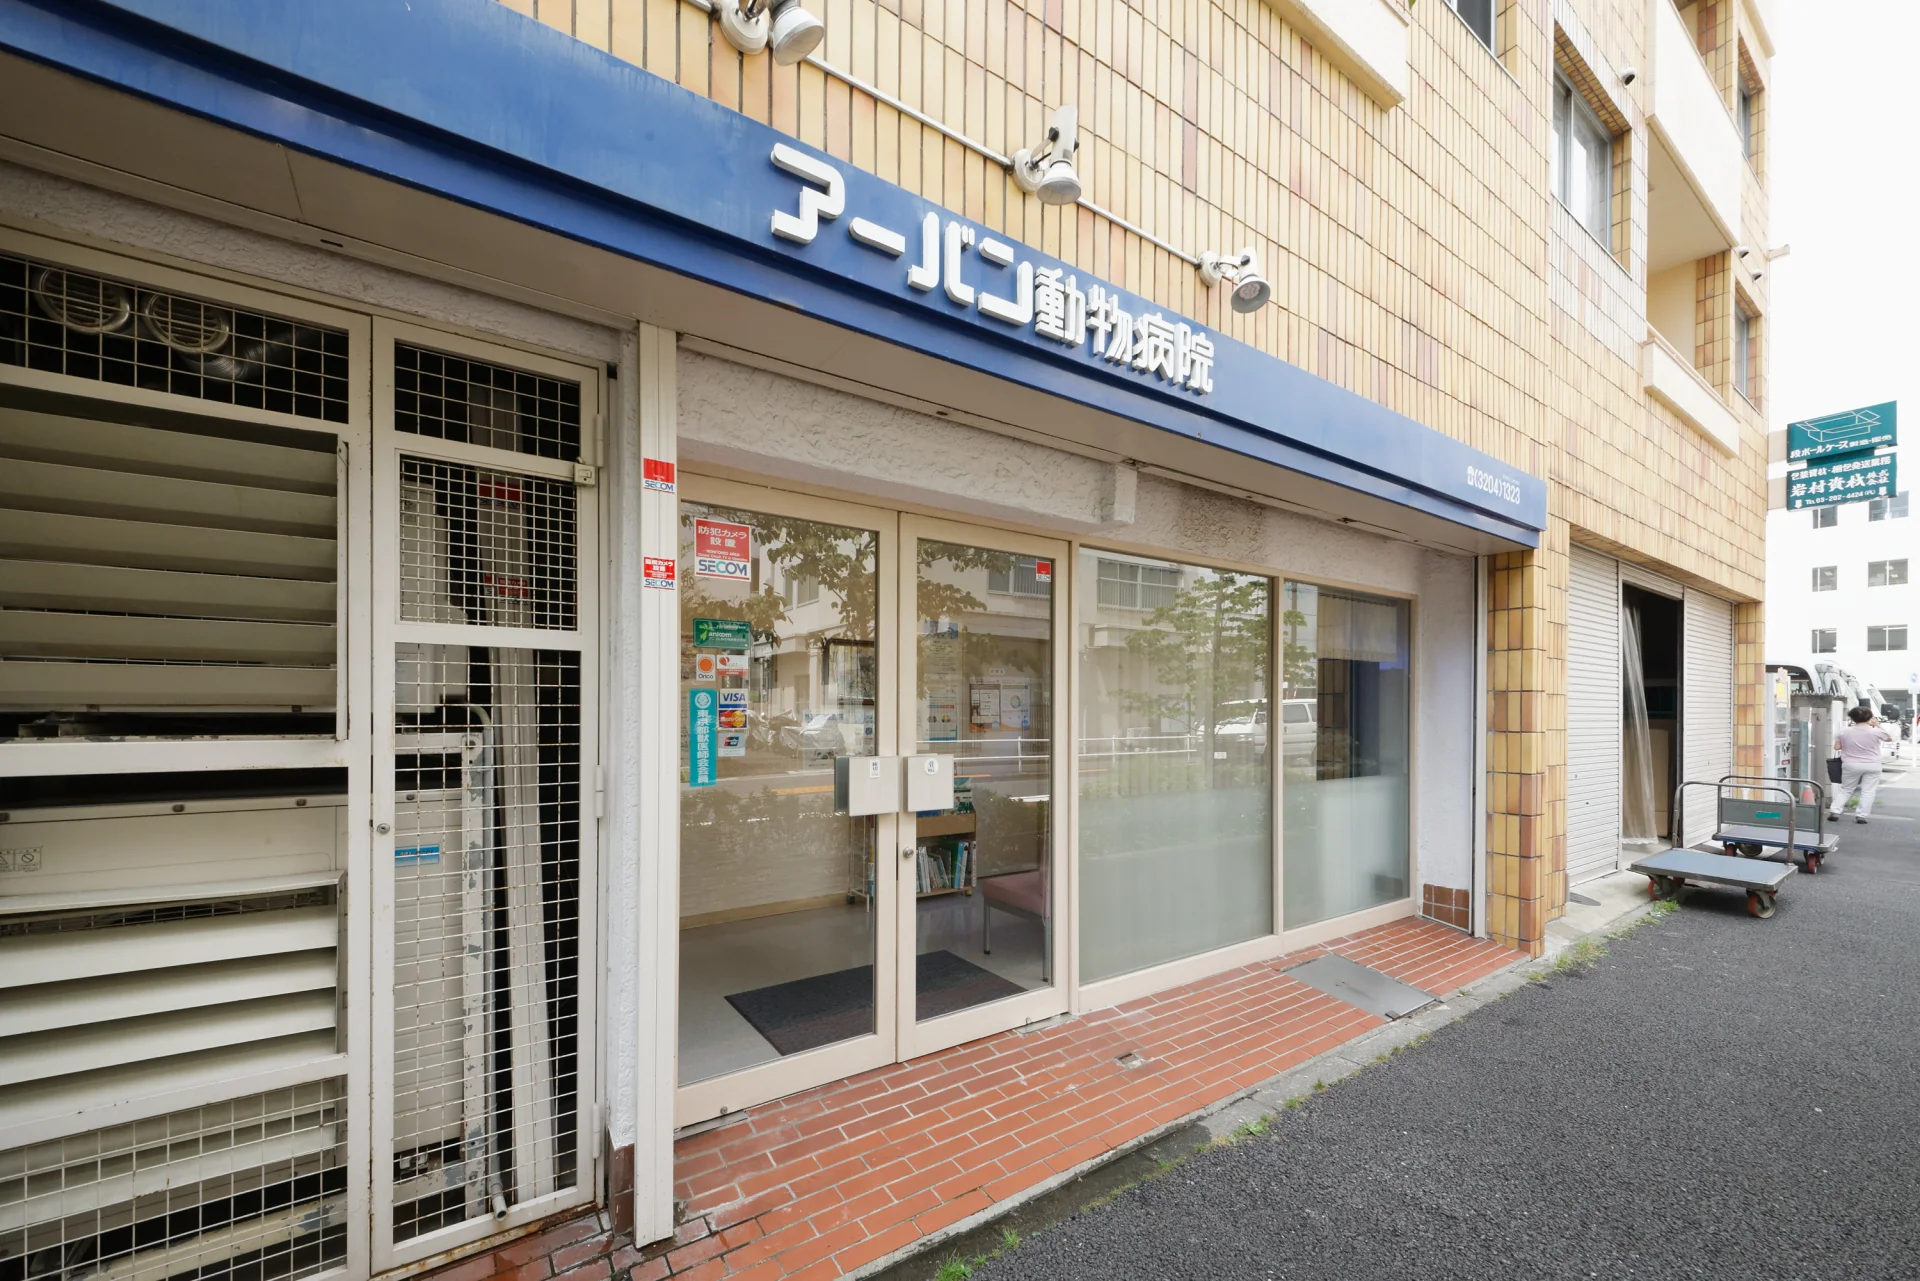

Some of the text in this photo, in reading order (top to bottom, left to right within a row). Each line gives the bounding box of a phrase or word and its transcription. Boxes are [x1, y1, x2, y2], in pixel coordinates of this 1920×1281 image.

[771, 142, 1214, 395] アーバン動物病院
[644, 479, 674, 491] SECOM
[698, 526, 747, 539] 防犯カメラ
[698, 559, 747, 576] SECOM
[645, 578, 674, 588] SECOM
[722, 693, 746, 702] VISA
